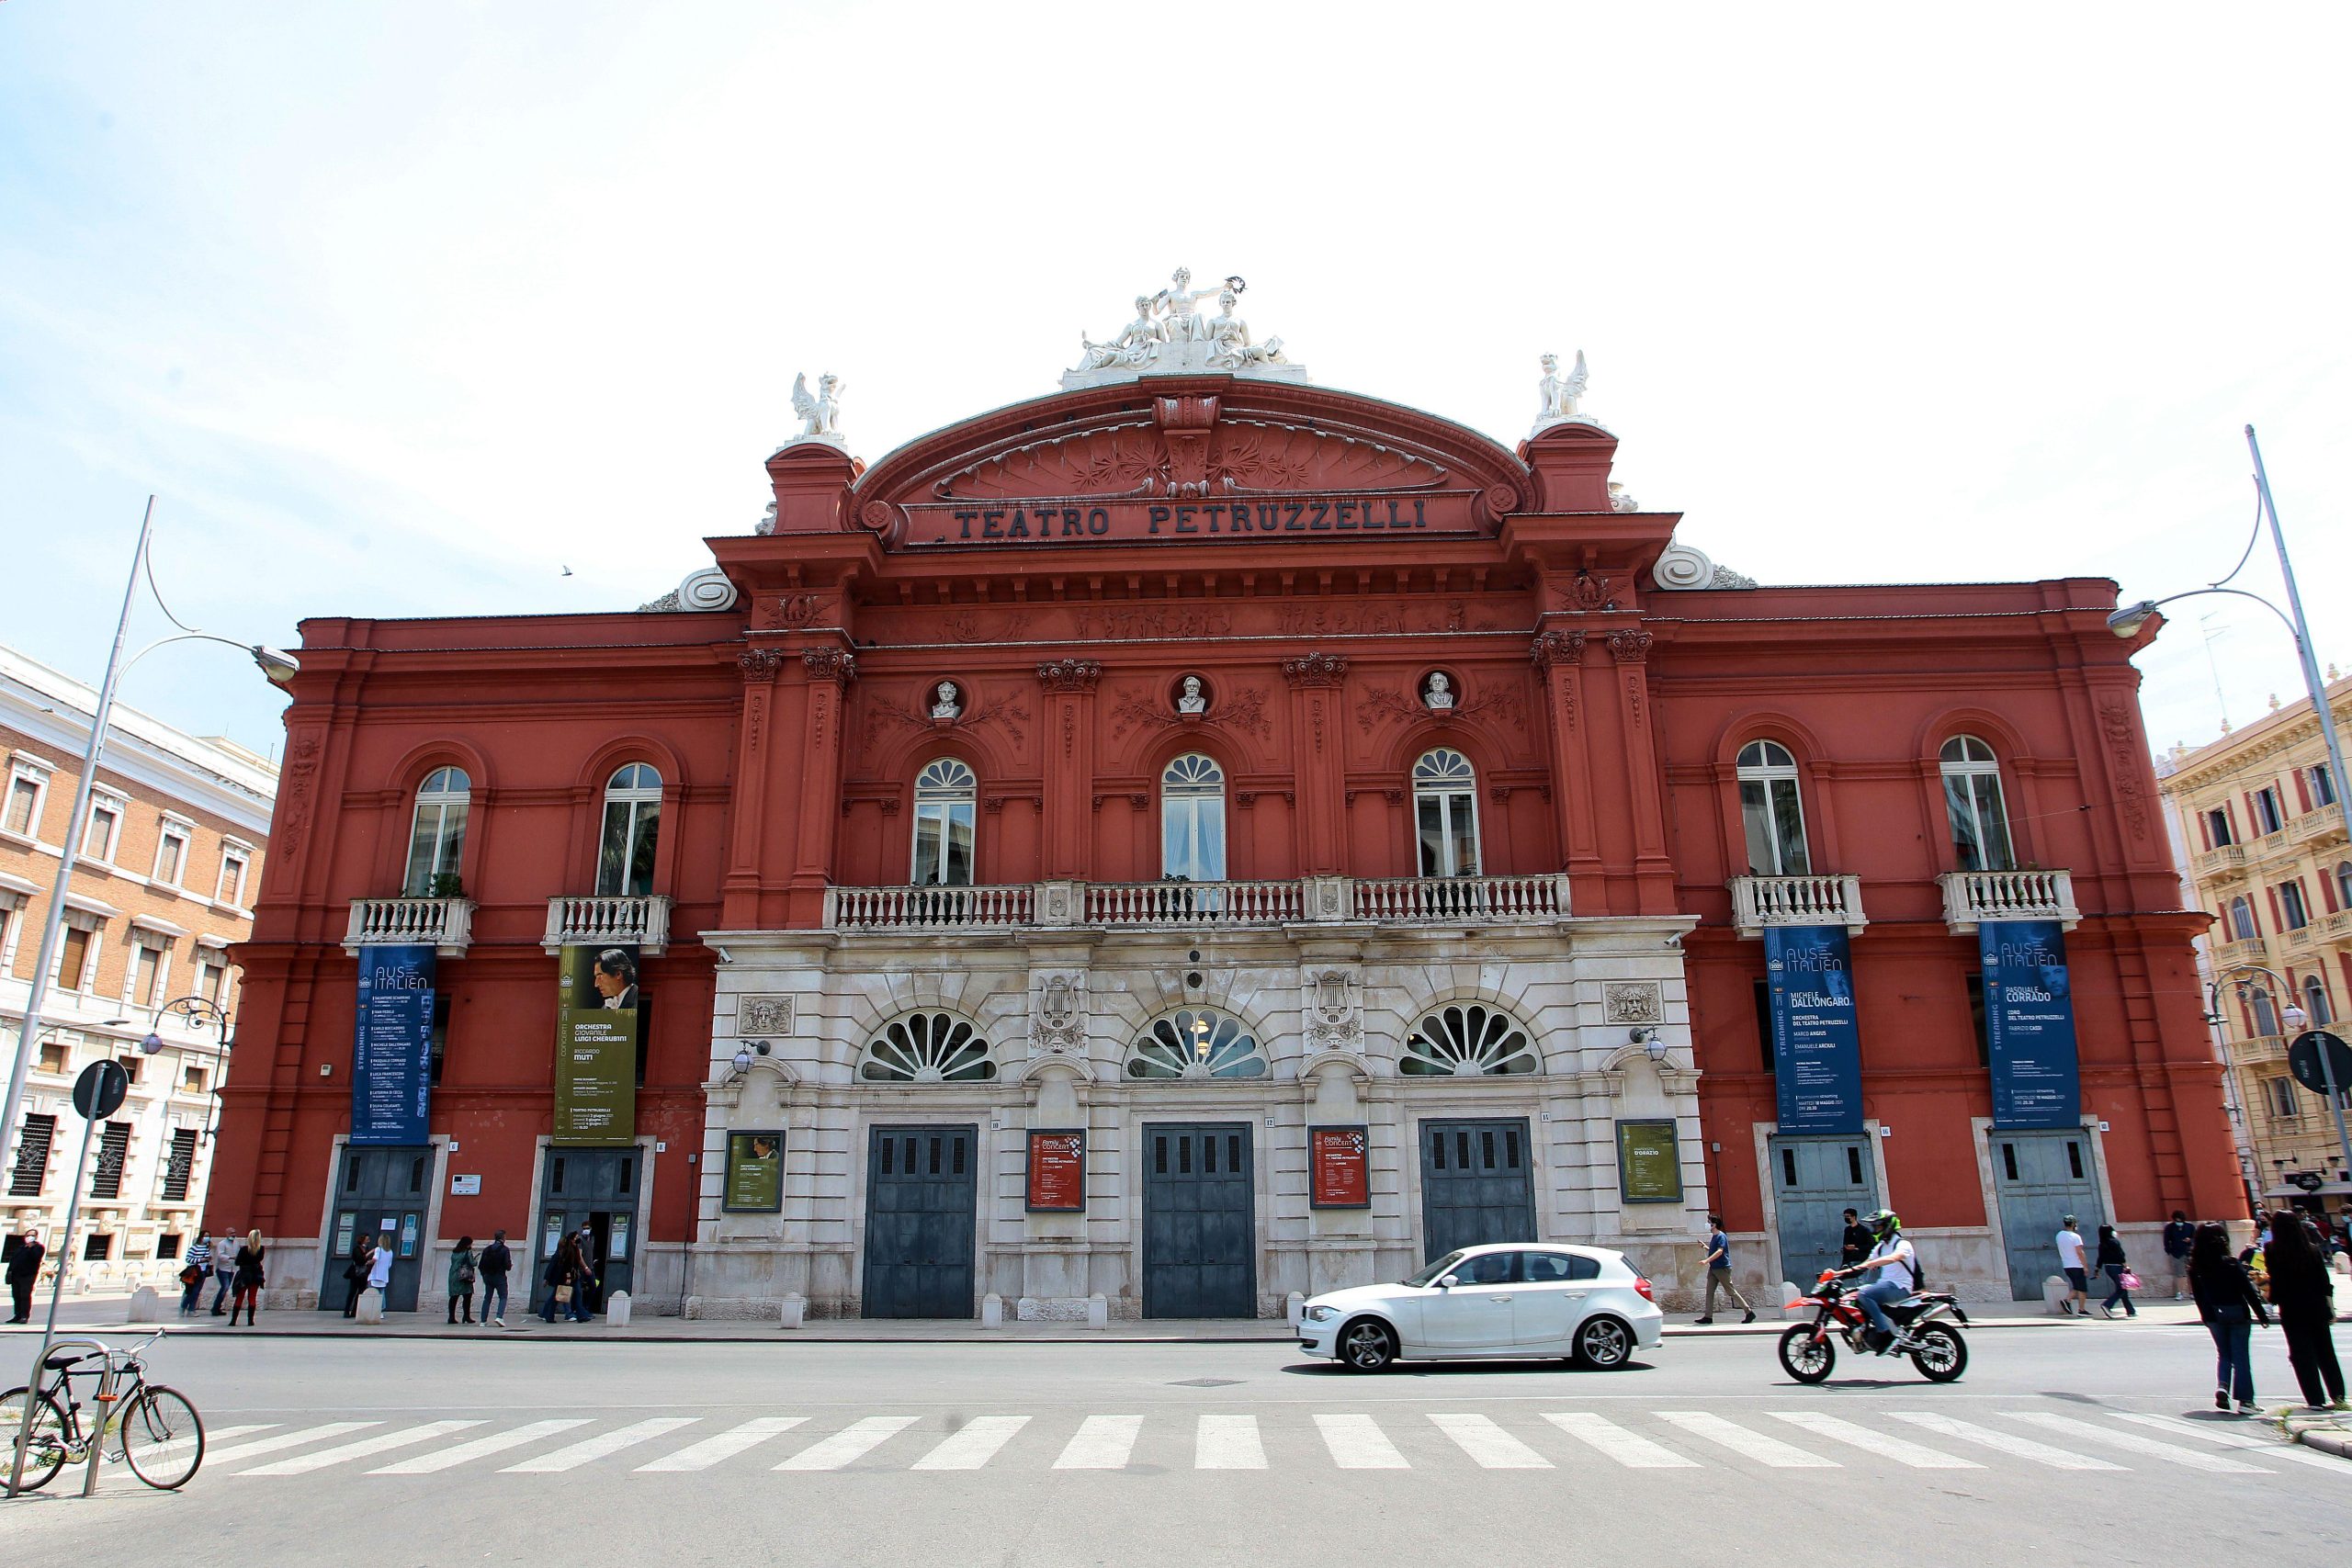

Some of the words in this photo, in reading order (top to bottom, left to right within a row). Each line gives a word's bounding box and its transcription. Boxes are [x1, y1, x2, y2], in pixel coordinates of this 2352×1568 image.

[954, 507, 1110, 539] TEATRO
[1148, 500, 1427, 533] PETRUZZELLI
[1786, 948, 1818, 960] AUS
[2001, 942, 2032, 955] AUS
[375, 966, 404, 978] AUS
[1792, 997, 1849, 1008] DALL'ONGARO
[2007, 992, 2051, 1002] CORRADO
